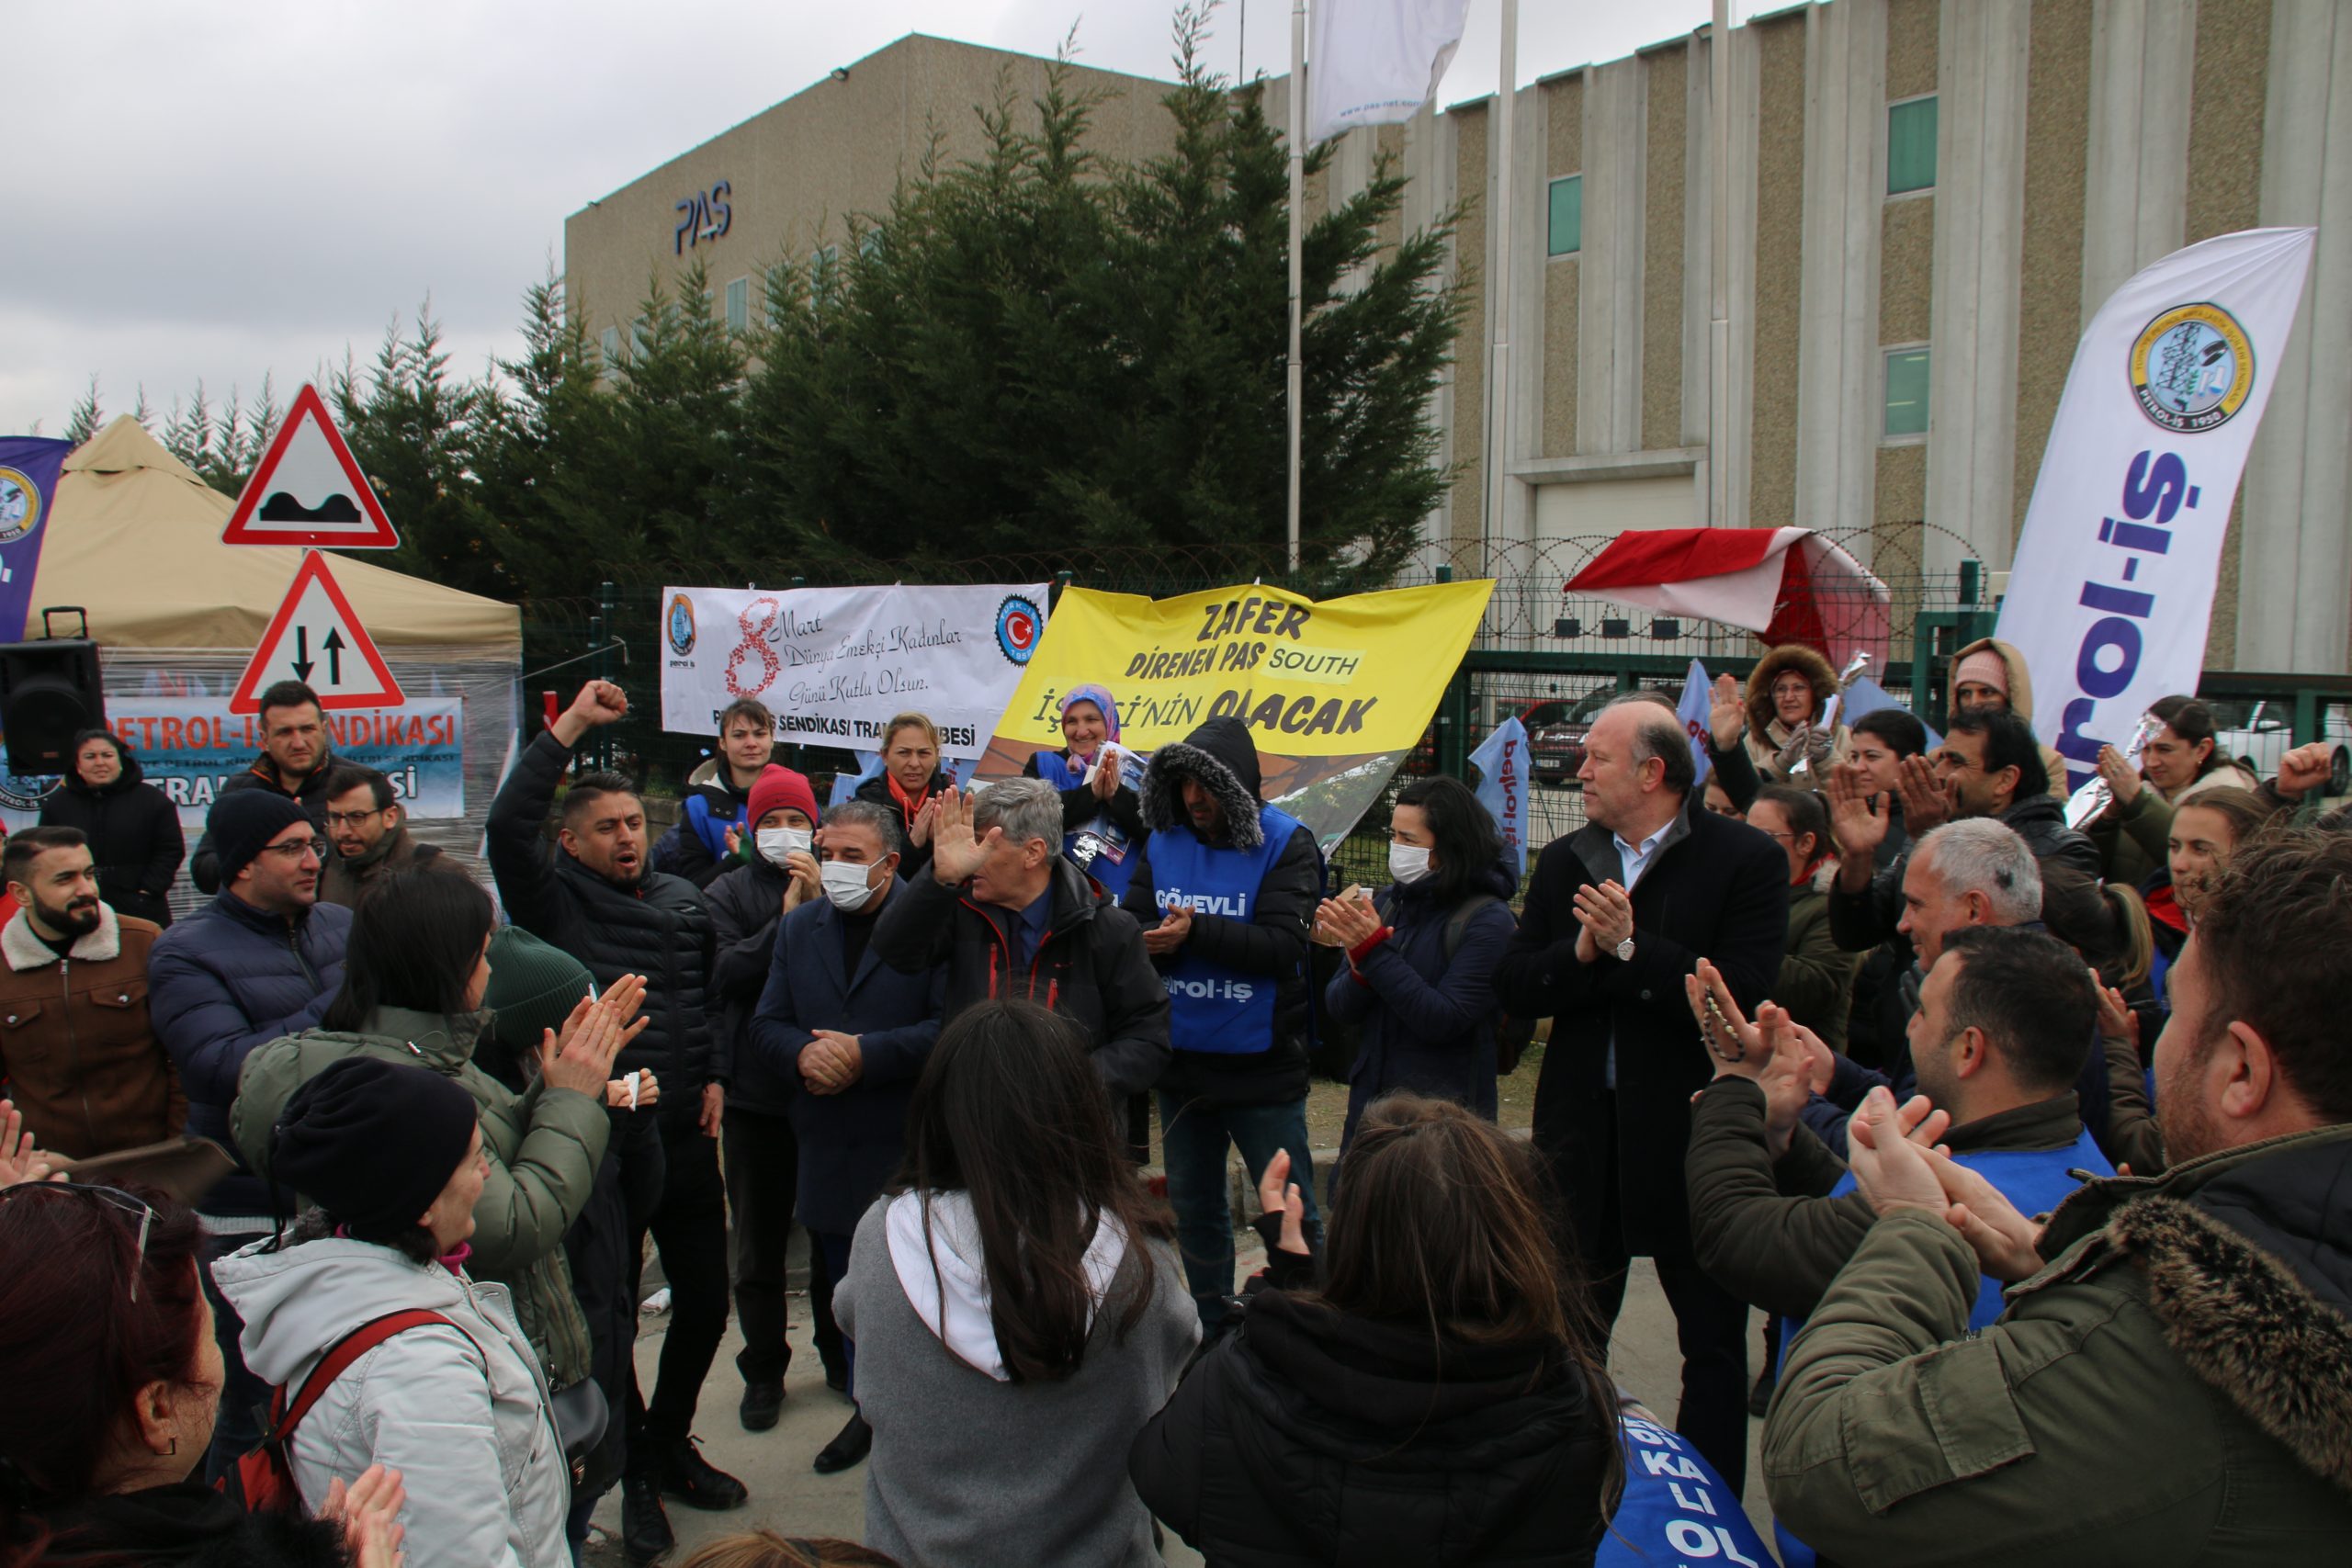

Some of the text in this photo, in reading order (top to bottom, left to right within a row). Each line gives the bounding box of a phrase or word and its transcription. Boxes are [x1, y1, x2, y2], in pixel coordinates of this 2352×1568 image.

[675, 180, 731, 255] PAS
[2190, 412, 2222, 428] 1950
[768, 610, 823, 643] Mart
[1196, 597, 1311, 642] ZAFER
[784, 618, 962, 673] Dünya Emekçi Kadınlar
[1125, 642, 1359, 680] DİRENEN PAS SOUTH
[789, 667, 929, 710] Günü Kutlu Olsun.
[779, 713, 851, 737] SENDİKASI
[1640, 1450, 1712, 1485] KA
[1668, 1482, 1717, 1516] LI
[1665, 1519, 1759, 1568] OL
